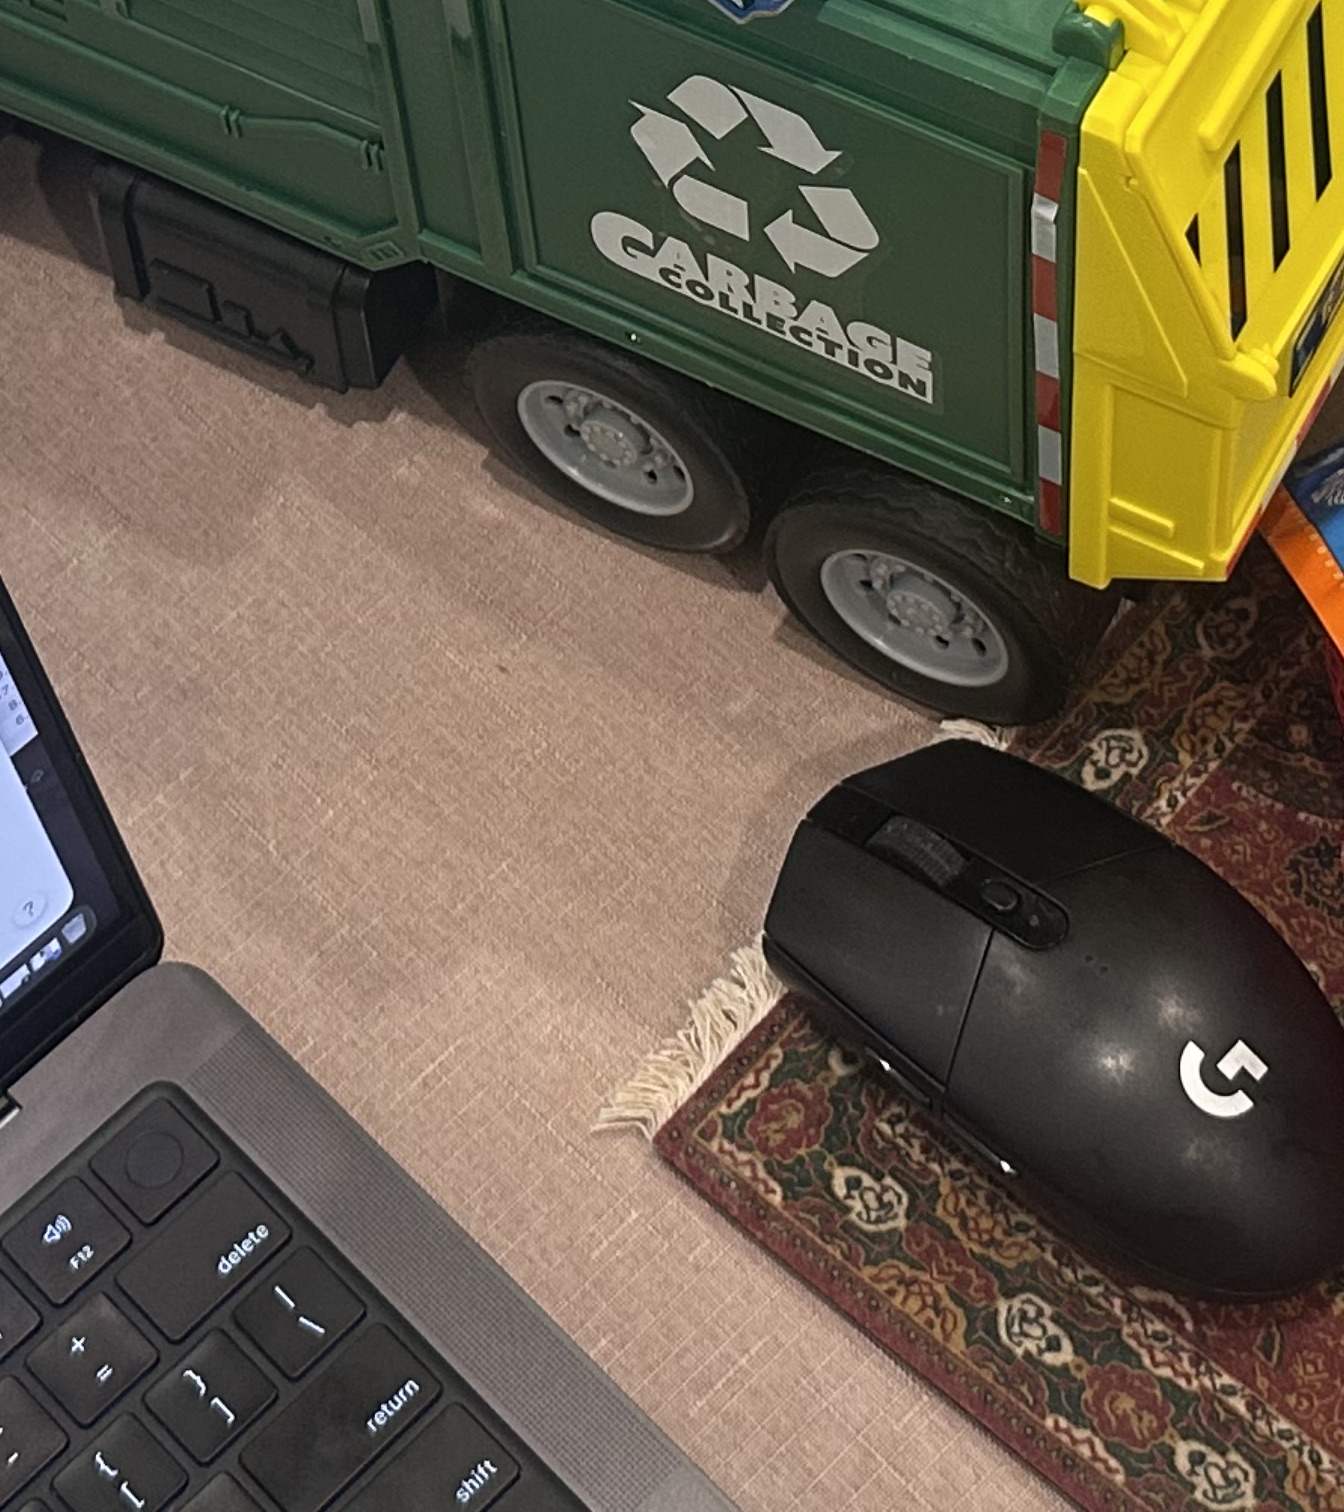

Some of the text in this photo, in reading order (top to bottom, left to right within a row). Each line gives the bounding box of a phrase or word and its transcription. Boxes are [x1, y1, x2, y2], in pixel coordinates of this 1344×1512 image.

[590, 210, 934, 376] GARBAGE
[657, 265, 931, 401] COLLECTION
[68, 1243, 97, 1272] F12
[214, 1221, 272, 1277] delete
[366, 1376, 423, 1433] return
[455, 1457, 501, 1505] shift
